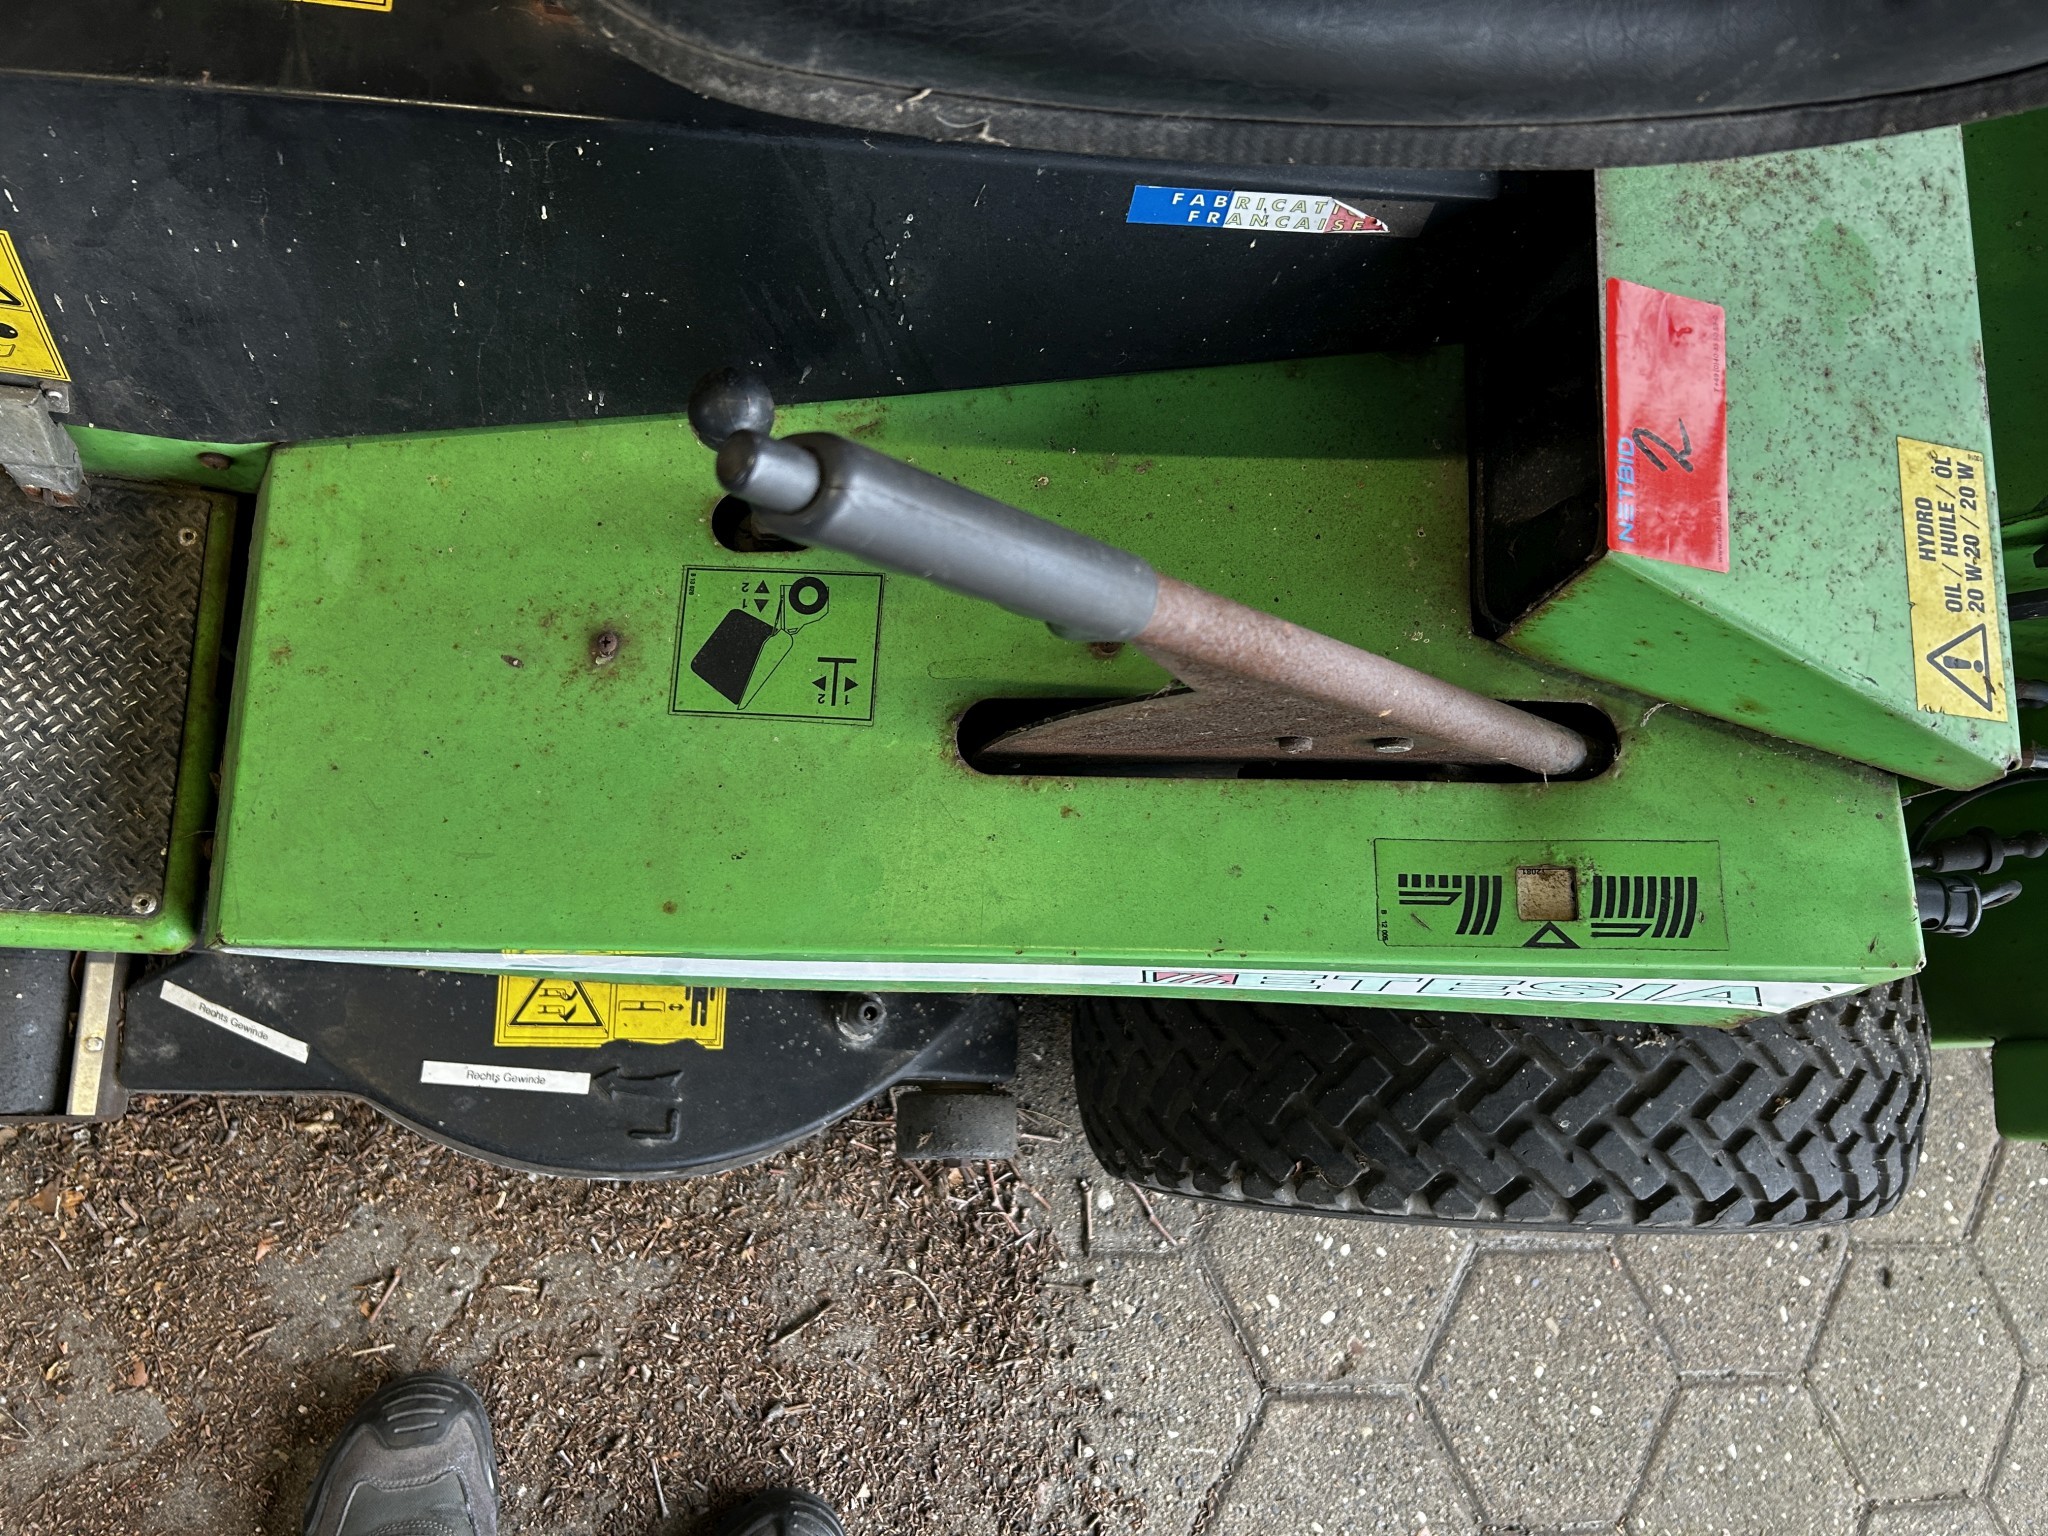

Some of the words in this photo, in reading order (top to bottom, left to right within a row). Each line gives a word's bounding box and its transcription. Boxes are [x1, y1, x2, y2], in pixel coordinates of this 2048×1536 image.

[1931, 457, 1952, 479] ÖL
[1957, 461, 1974, 480] W
[1618, 437, 1635, 543] NETBID
[1936, 484, 1956, 499] /
[1959, 486, 1977, 511] 20
[1915, 497, 1937, 562] HYDRO
[1938, 501, 1958, 557] HUILE
[1960, 514, 1980, 529] /
[1942, 562, 1963, 577] /
[741, 582, 750, 592] 2
[1944, 583, 1963, 613] OIL
[1967, 588, 1985, 613] 20
[817, 693, 826, 704] 2
[1234, 972, 1763, 1007] ETESIA
[230, 1017, 268, 1041] Gewinde
[466, 1070, 500, 1082] Rechts
[503, 1072, 546, 1085] Gewinde
